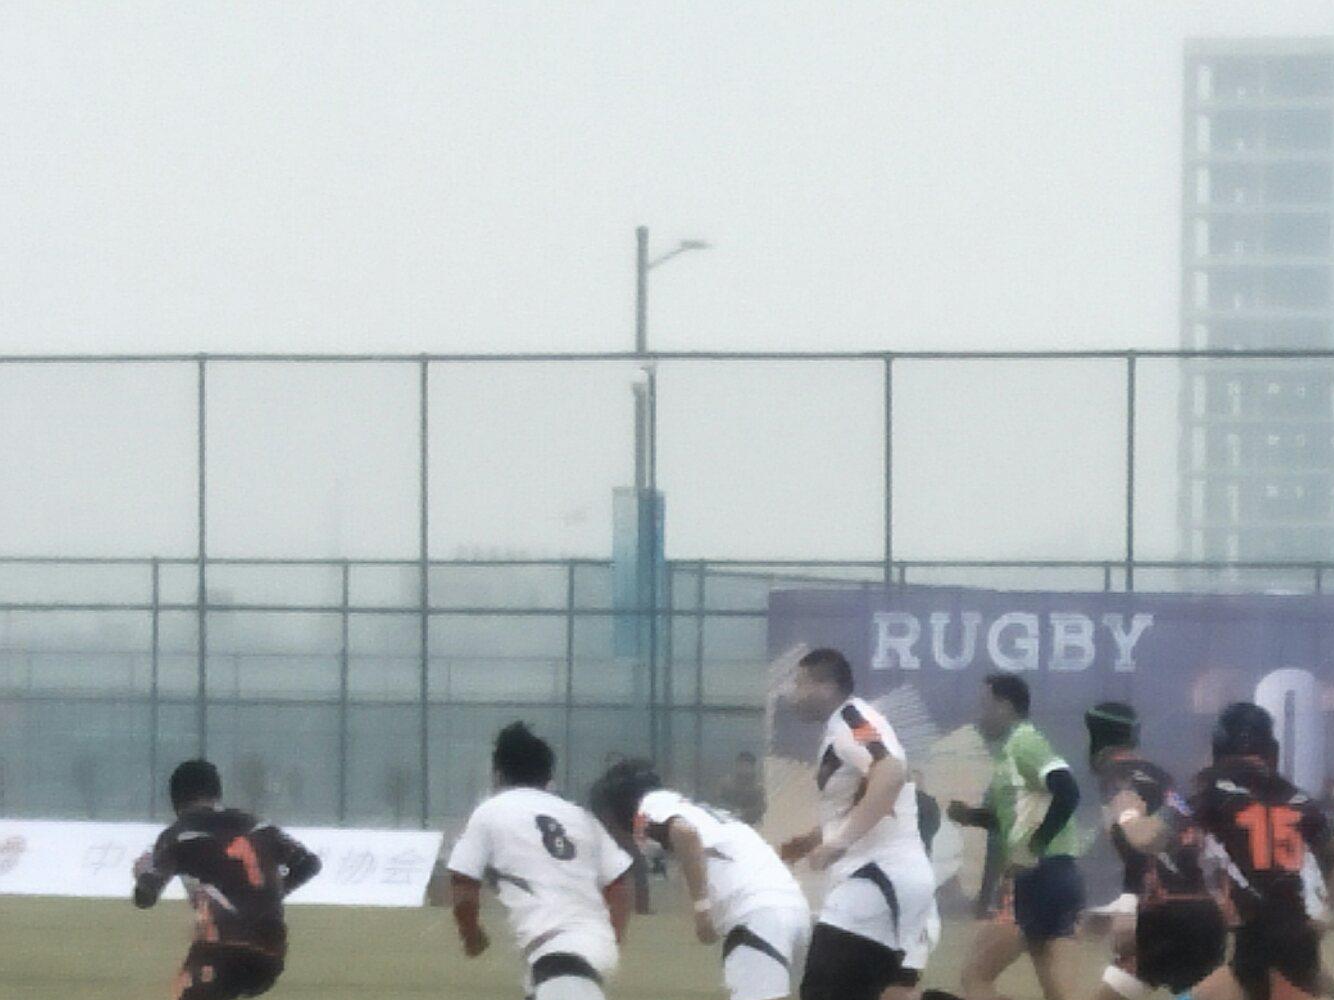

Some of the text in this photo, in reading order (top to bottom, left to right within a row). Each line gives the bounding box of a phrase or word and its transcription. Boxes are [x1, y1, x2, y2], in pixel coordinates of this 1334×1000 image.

[870, 611, 1154, 672] RUGBY
[534, 813, 578, 861] 8
[1235, 802, 1303, 872] 15
